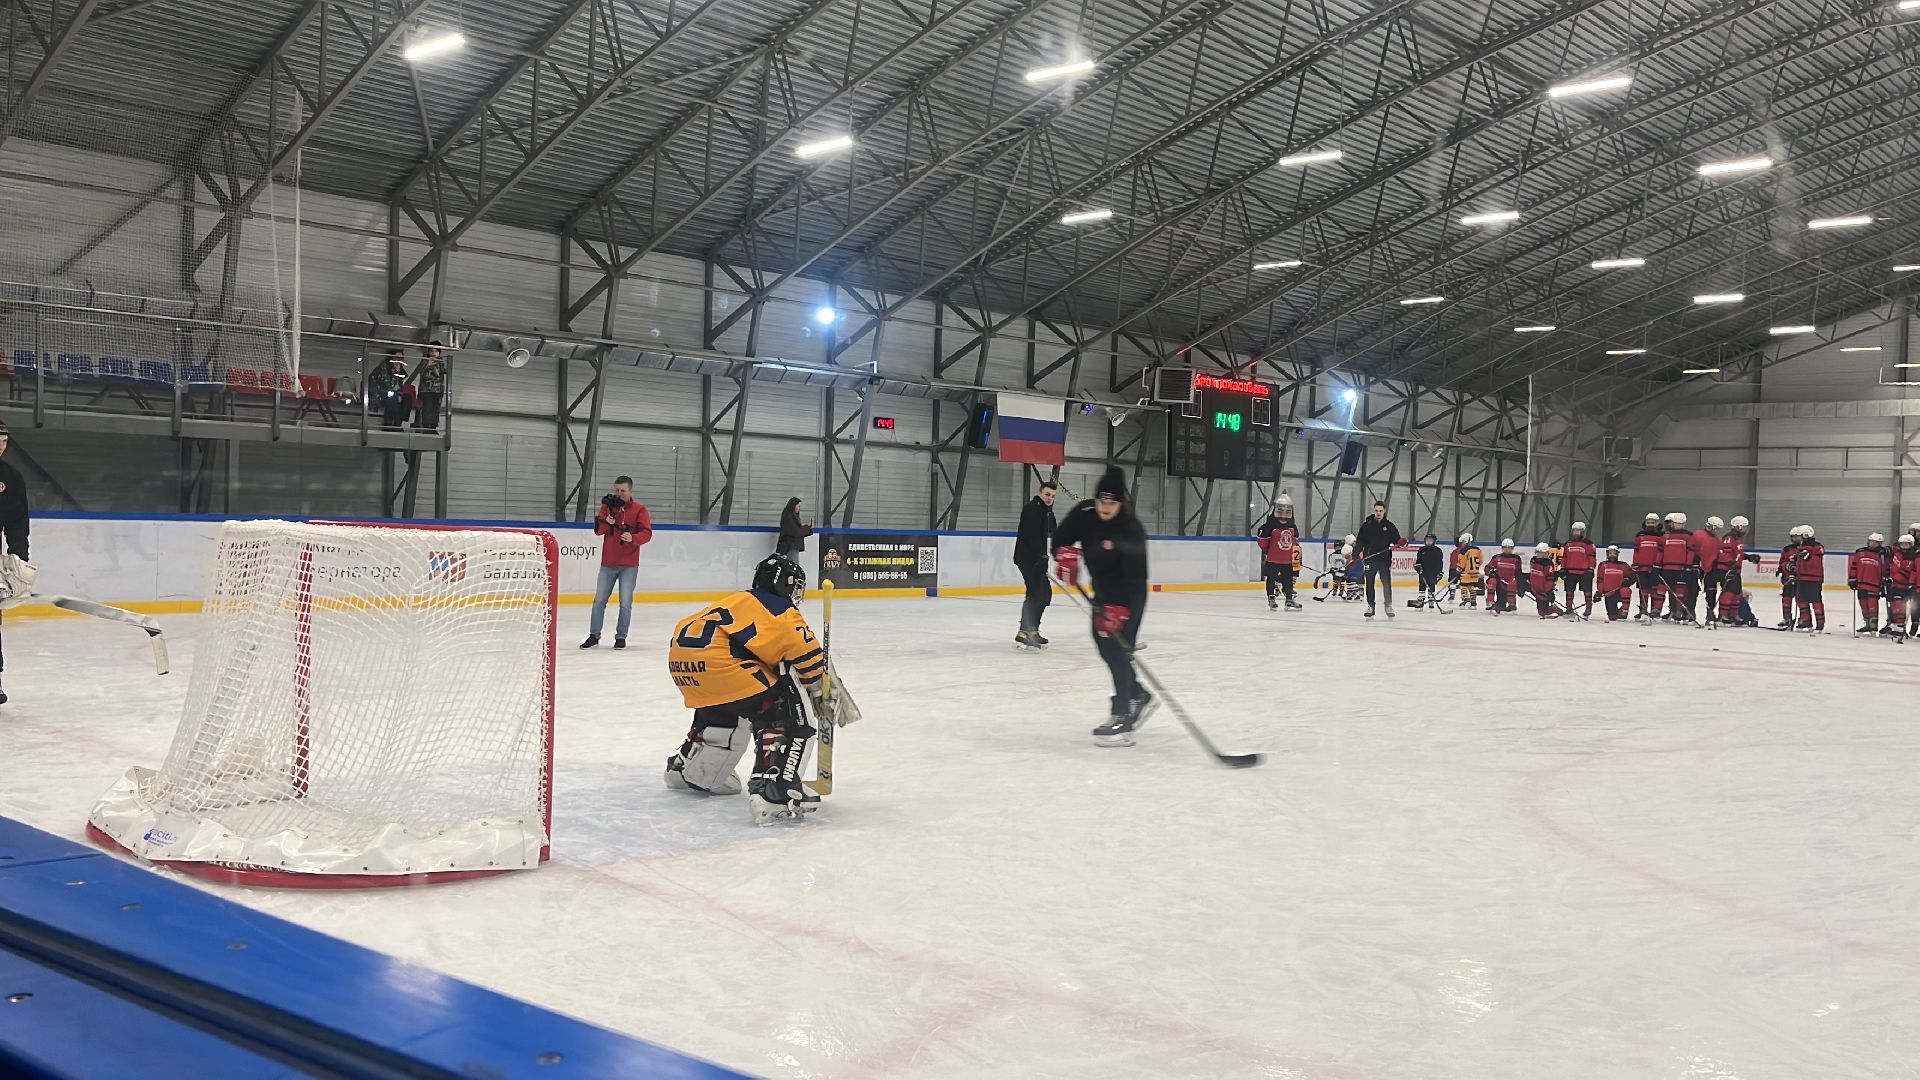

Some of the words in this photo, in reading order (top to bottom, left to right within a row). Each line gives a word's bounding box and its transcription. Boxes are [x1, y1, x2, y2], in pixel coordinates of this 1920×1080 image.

[560, 546, 598, 558] округ
[1469, 556, 1480, 571] 15
[853, 571, 859, 580] 8
[782, 737, 805, 782] VAUGHN
